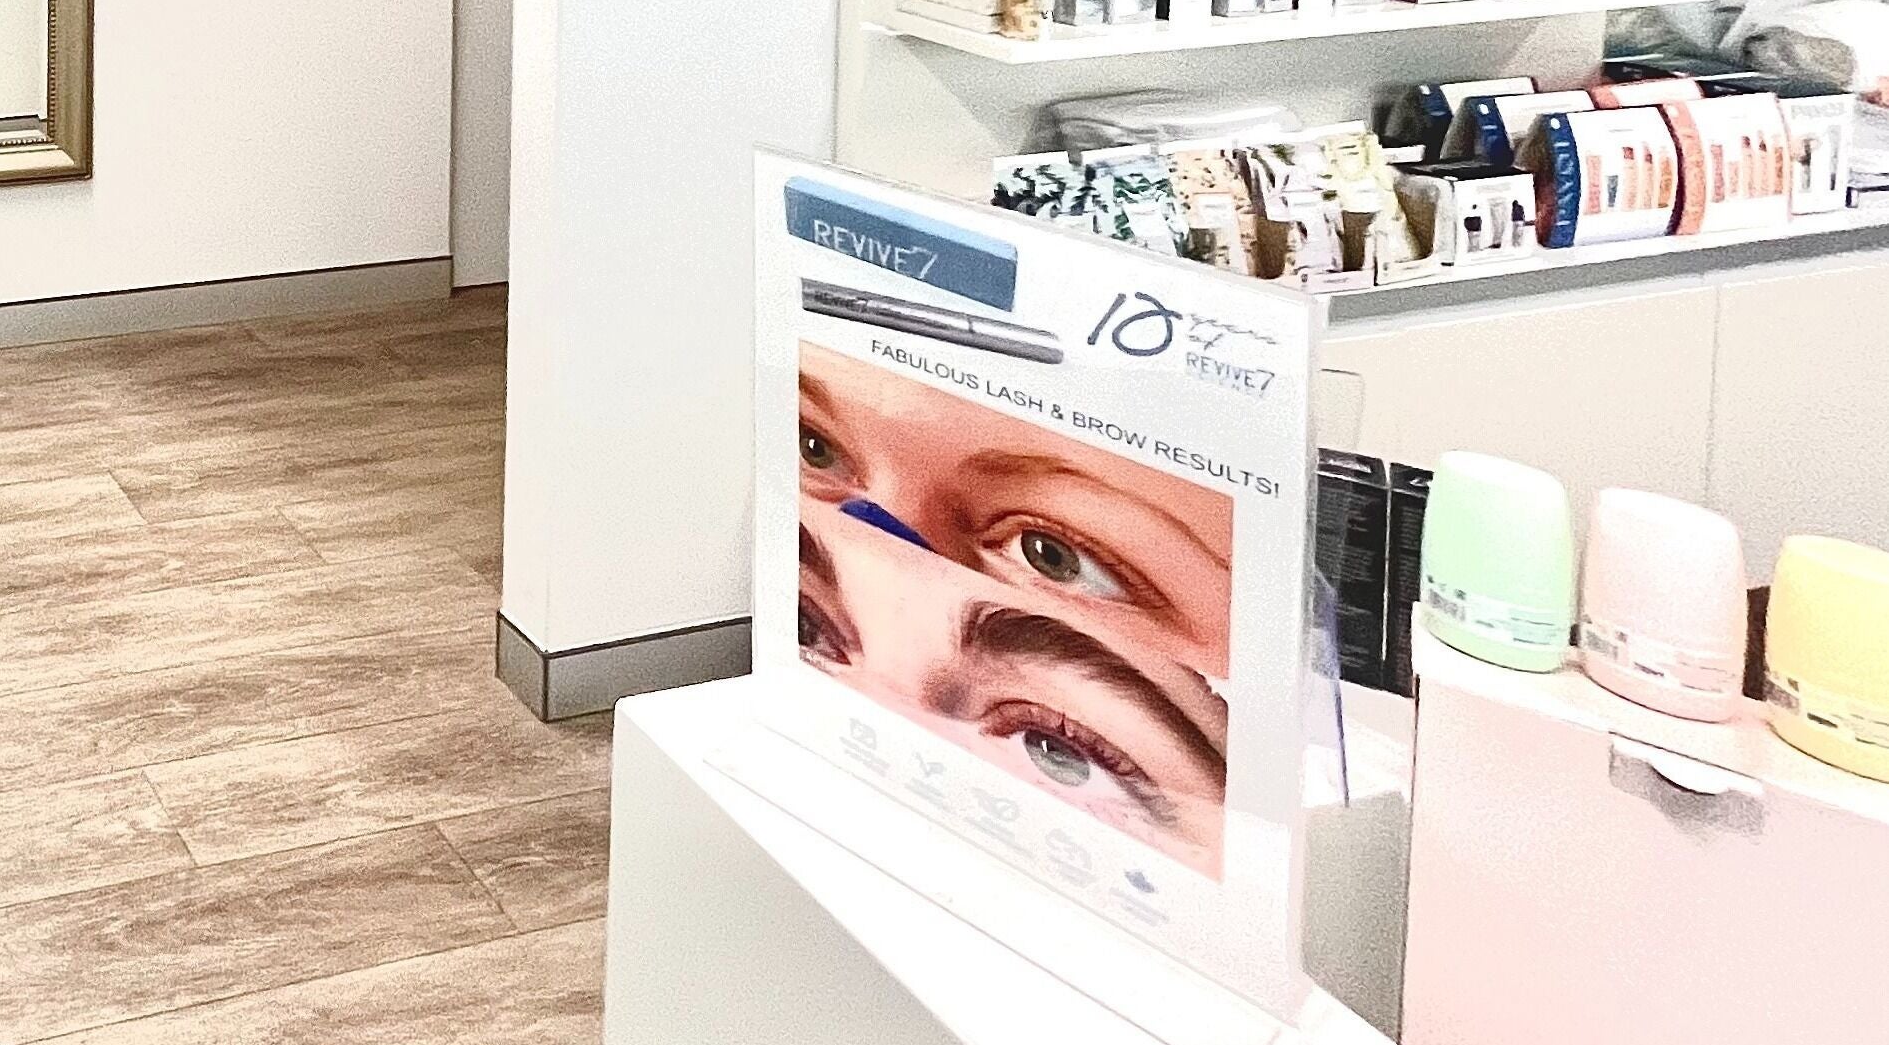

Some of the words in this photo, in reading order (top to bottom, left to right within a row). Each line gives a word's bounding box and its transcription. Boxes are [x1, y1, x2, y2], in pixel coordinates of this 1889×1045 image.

[814, 219, 938, 279] REVIVE7
[1087, 291, 1184, 357] 10
[1186, 351, 1276, 392] REVIVE7
[871, 339, 979, 390] FABULOUS
[986, 380, 1043, 413] LASH
[1051, 403, 1064, 421] &
[1072, 411, 1146, 449] BROW
[1154, 440, 1280, 499] RESULTS!
